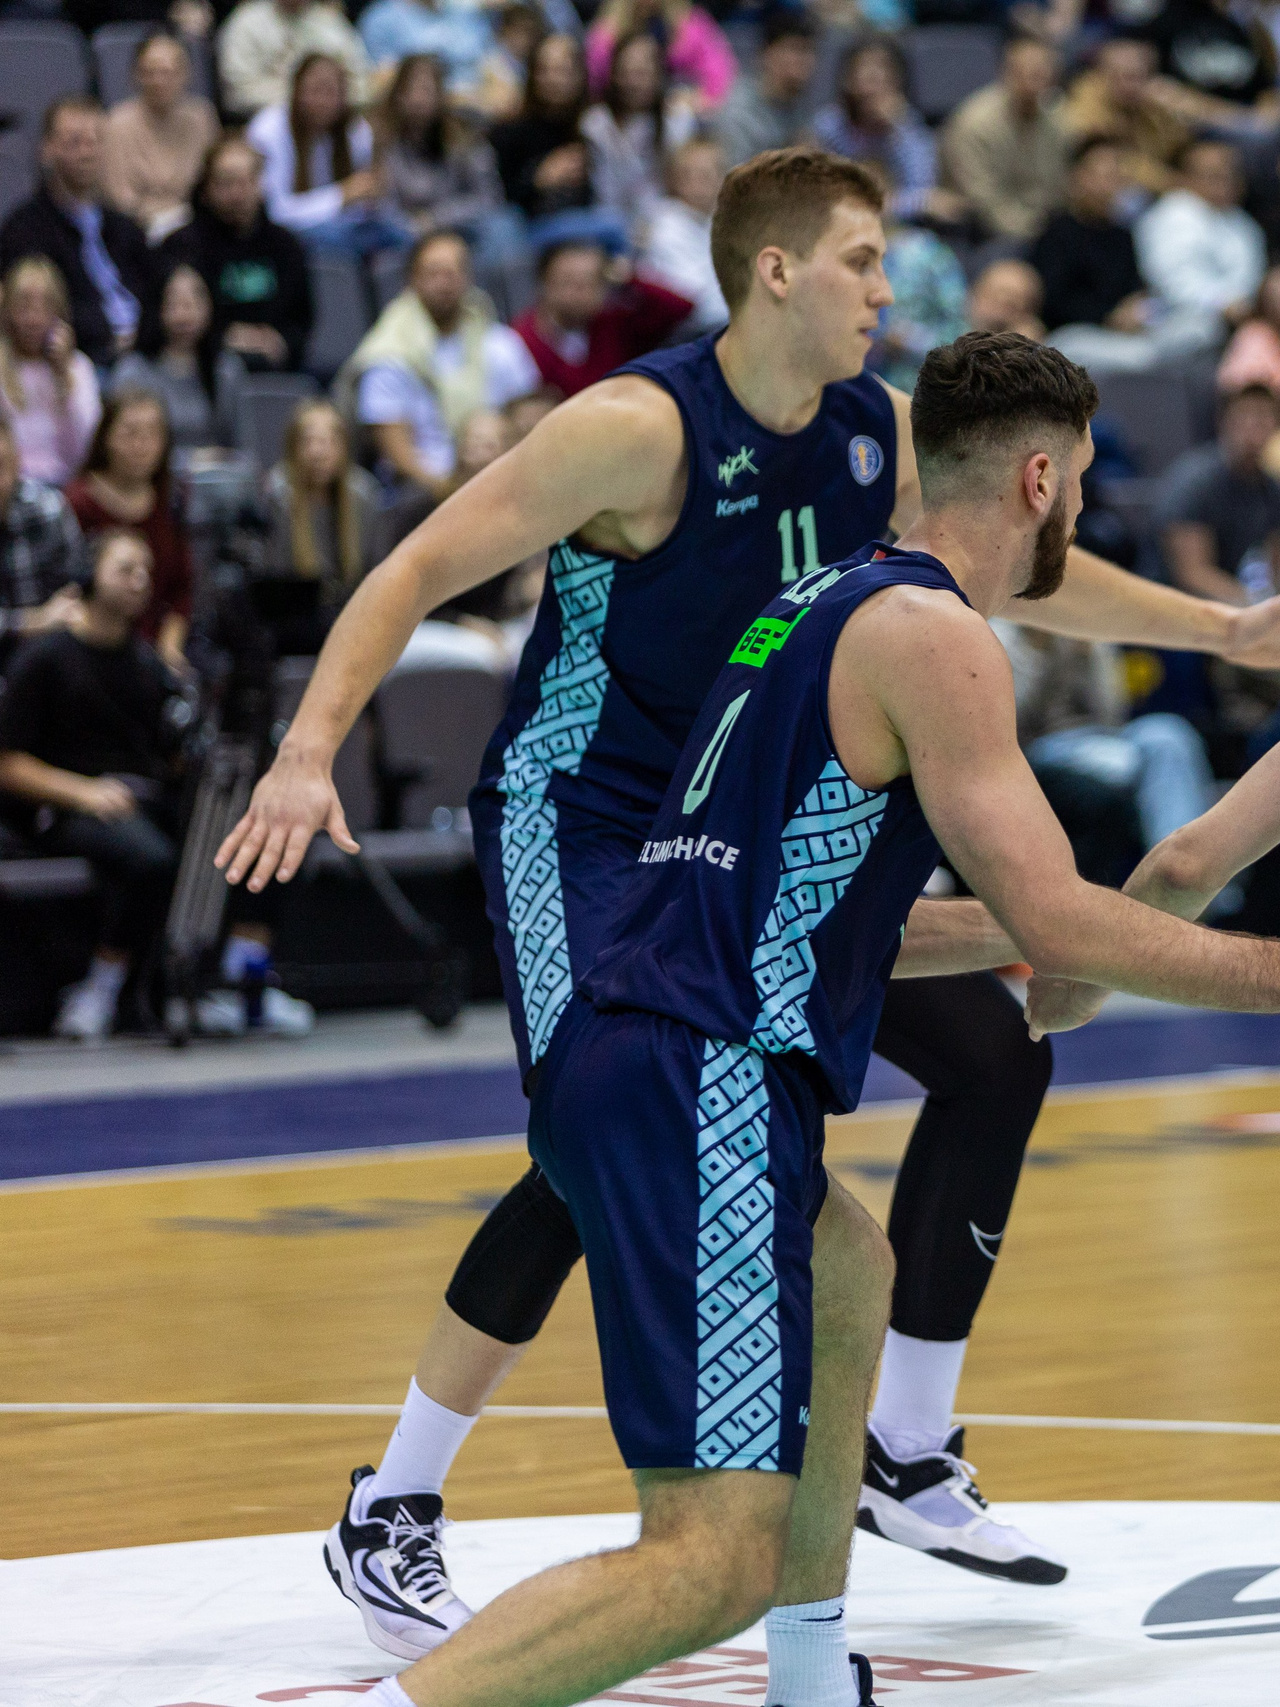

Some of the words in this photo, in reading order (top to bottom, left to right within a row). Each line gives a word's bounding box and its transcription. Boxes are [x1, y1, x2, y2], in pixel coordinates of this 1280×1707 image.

[715, 494, 760, 518] Kempa
[778, 505, 822, 584] 11
[682, 689, 751, 814] 0
